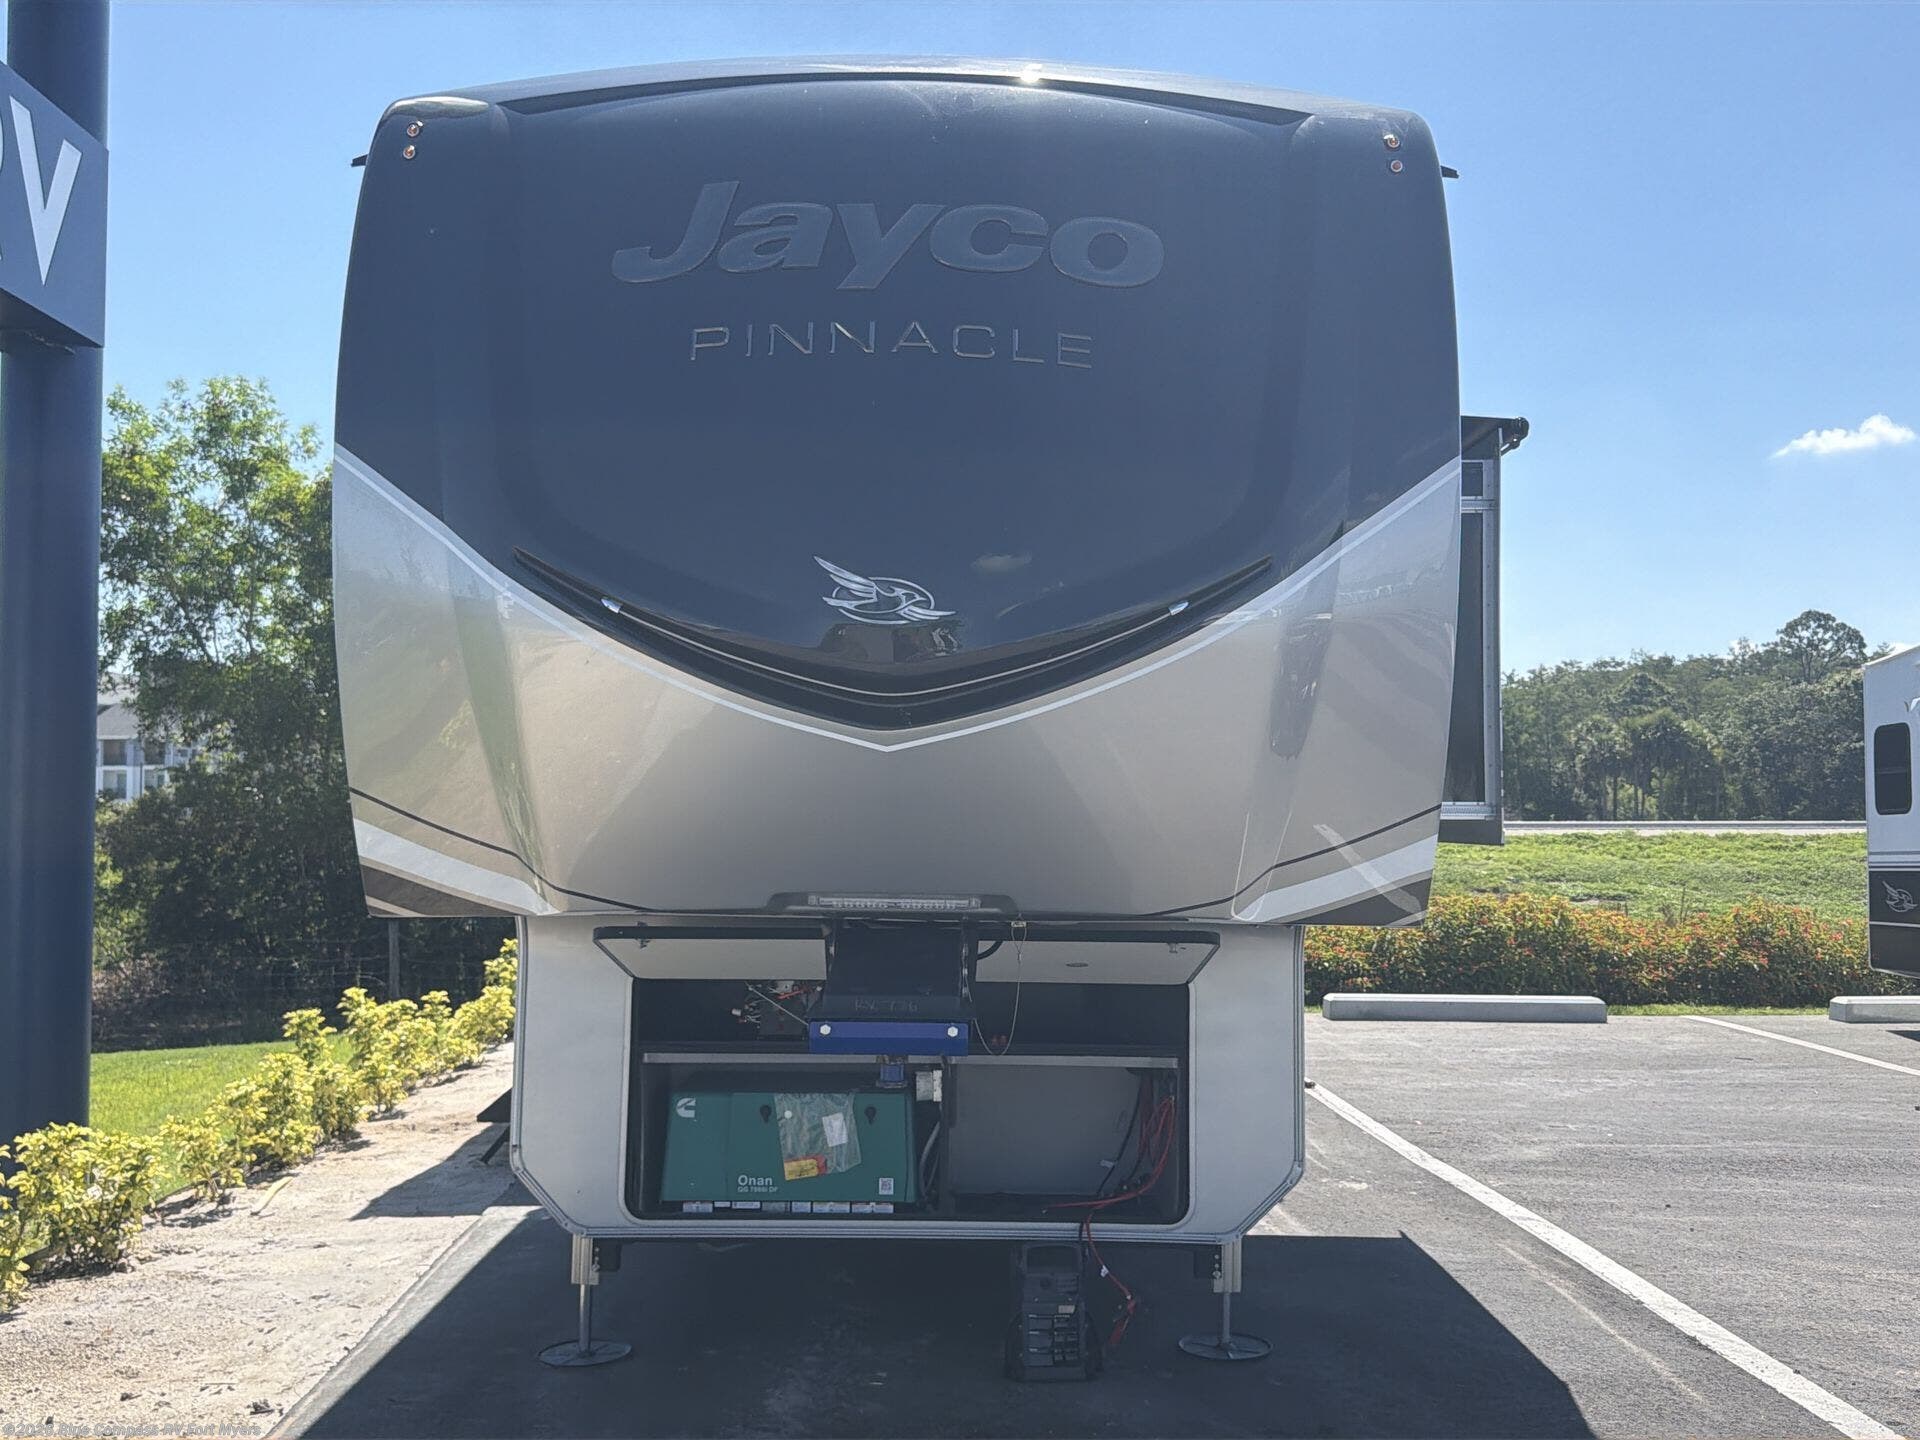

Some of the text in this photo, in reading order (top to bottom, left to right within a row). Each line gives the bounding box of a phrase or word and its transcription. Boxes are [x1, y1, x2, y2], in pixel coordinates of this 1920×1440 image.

[0, 95, 82, 286] V
[611, 180, 1165, 290] Jayco
[690, 320, 1093, 369] PINNACLE
[737, 1174, 773, 1186] Onan
